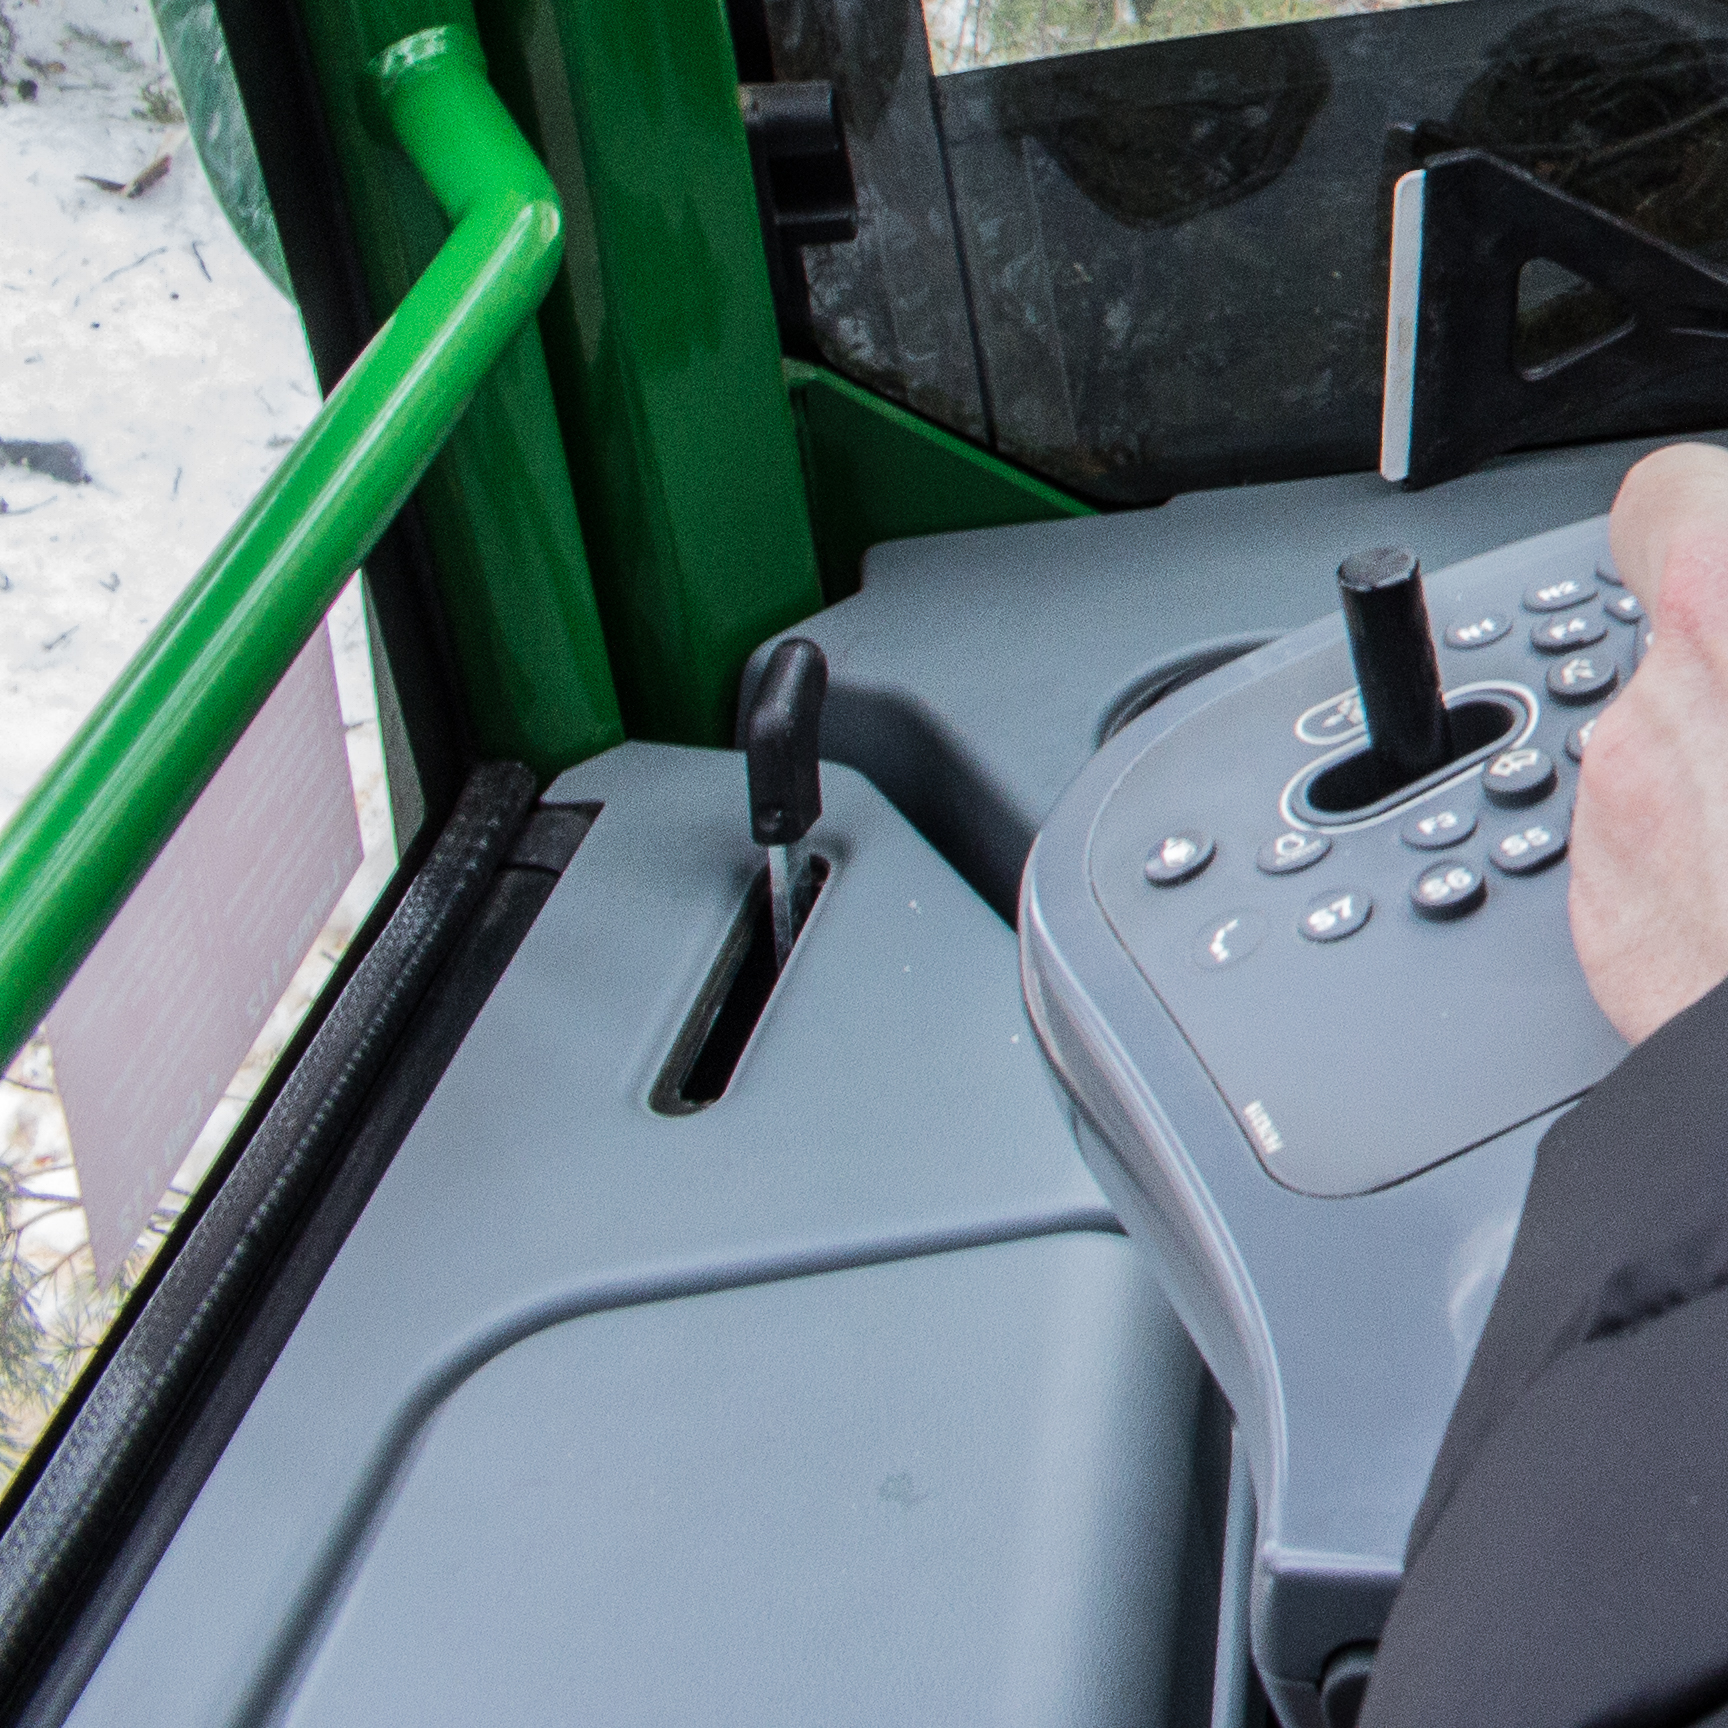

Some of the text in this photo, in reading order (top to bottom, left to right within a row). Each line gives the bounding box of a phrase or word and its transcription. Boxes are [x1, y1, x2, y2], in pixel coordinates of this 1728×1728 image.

[1500, 826, 1551, 857] S5
[1420, 866, 1473, 900] S6
[1307, 893, 1354, 932] S7
